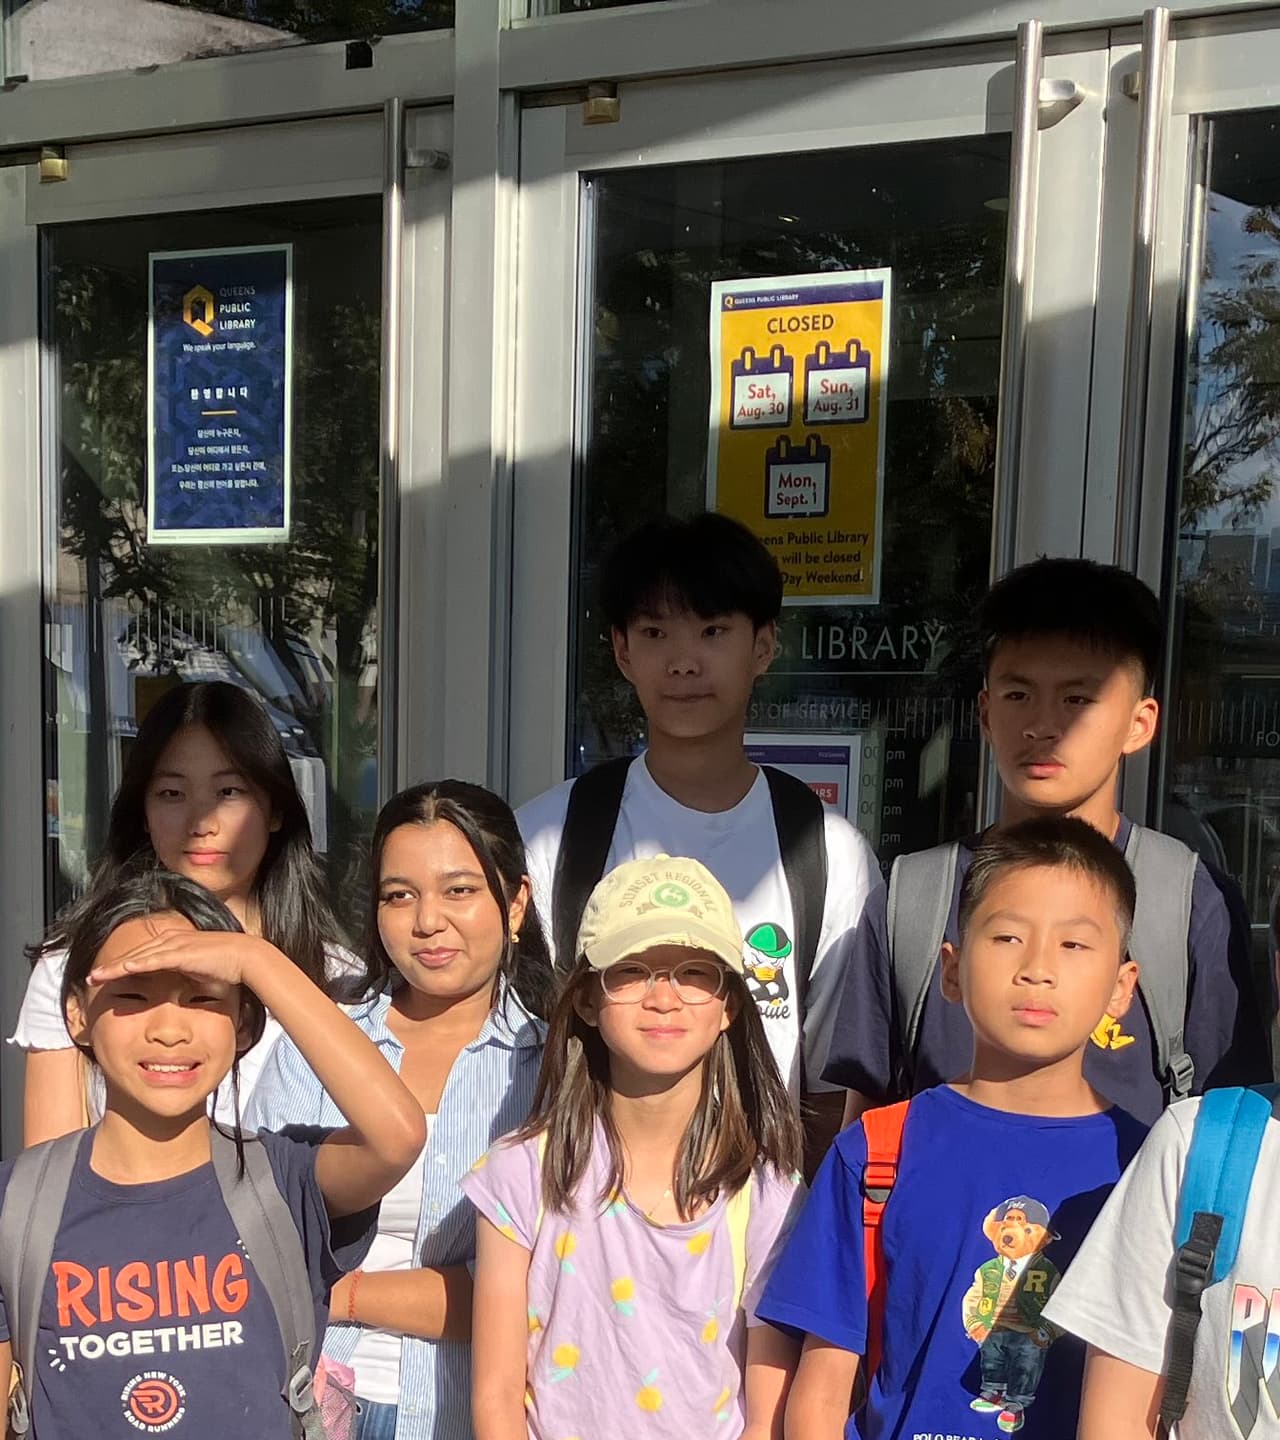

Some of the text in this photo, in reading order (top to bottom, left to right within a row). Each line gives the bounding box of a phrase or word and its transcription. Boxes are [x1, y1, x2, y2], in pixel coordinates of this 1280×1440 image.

[219, 285, 256, 297] QUEENS
[735, 297, 756, 305] QUEENS
[756, 295, 776, 304] PUBLIC
[776, 294, 799, 302] LIBRARY
[219, 302, 252, 314] PUBLIC
[219, 319, 256, 330] LIBRARY
[767, 314, 834, 334] CLOSED
[183, 343, 194, 352] We
[194, 343, 212, 353] speak
[212, 343, 226, 352] your
[748, 383, 776, 401] Sat,
[820, 378, 854, 397] Sun,
[737, 402, 784, 420] Aug. 30
[813, 398, 859, 415] Aug. 31
[778, 472, 817, 490] Mon,
[776, 492, 817, 508] Sept. 1
[787, 532, 823, 545] Public
[827, 530, 869, 546] Library
[782, 552, 801, 565] will
[805, 552, 820, 564] be
[823, 551, 861, 563] closed
[782, 570, 864, 587] Day Weekend.
[801, 625, 945, 660] LIBRARY
[767, 703, 790, 720] OF
[798, 703, 871, 720] SERVICE
[619, 871, 660, 908] SUNSET
[52, 1253, 250, 1328] RISING
[59, 1320, 244, 1361] TOGETHER
[120, 1371, 187, 1401] RISING NEW YORK
[123, 1407, 186, 1433] ROAD RUNNERS
